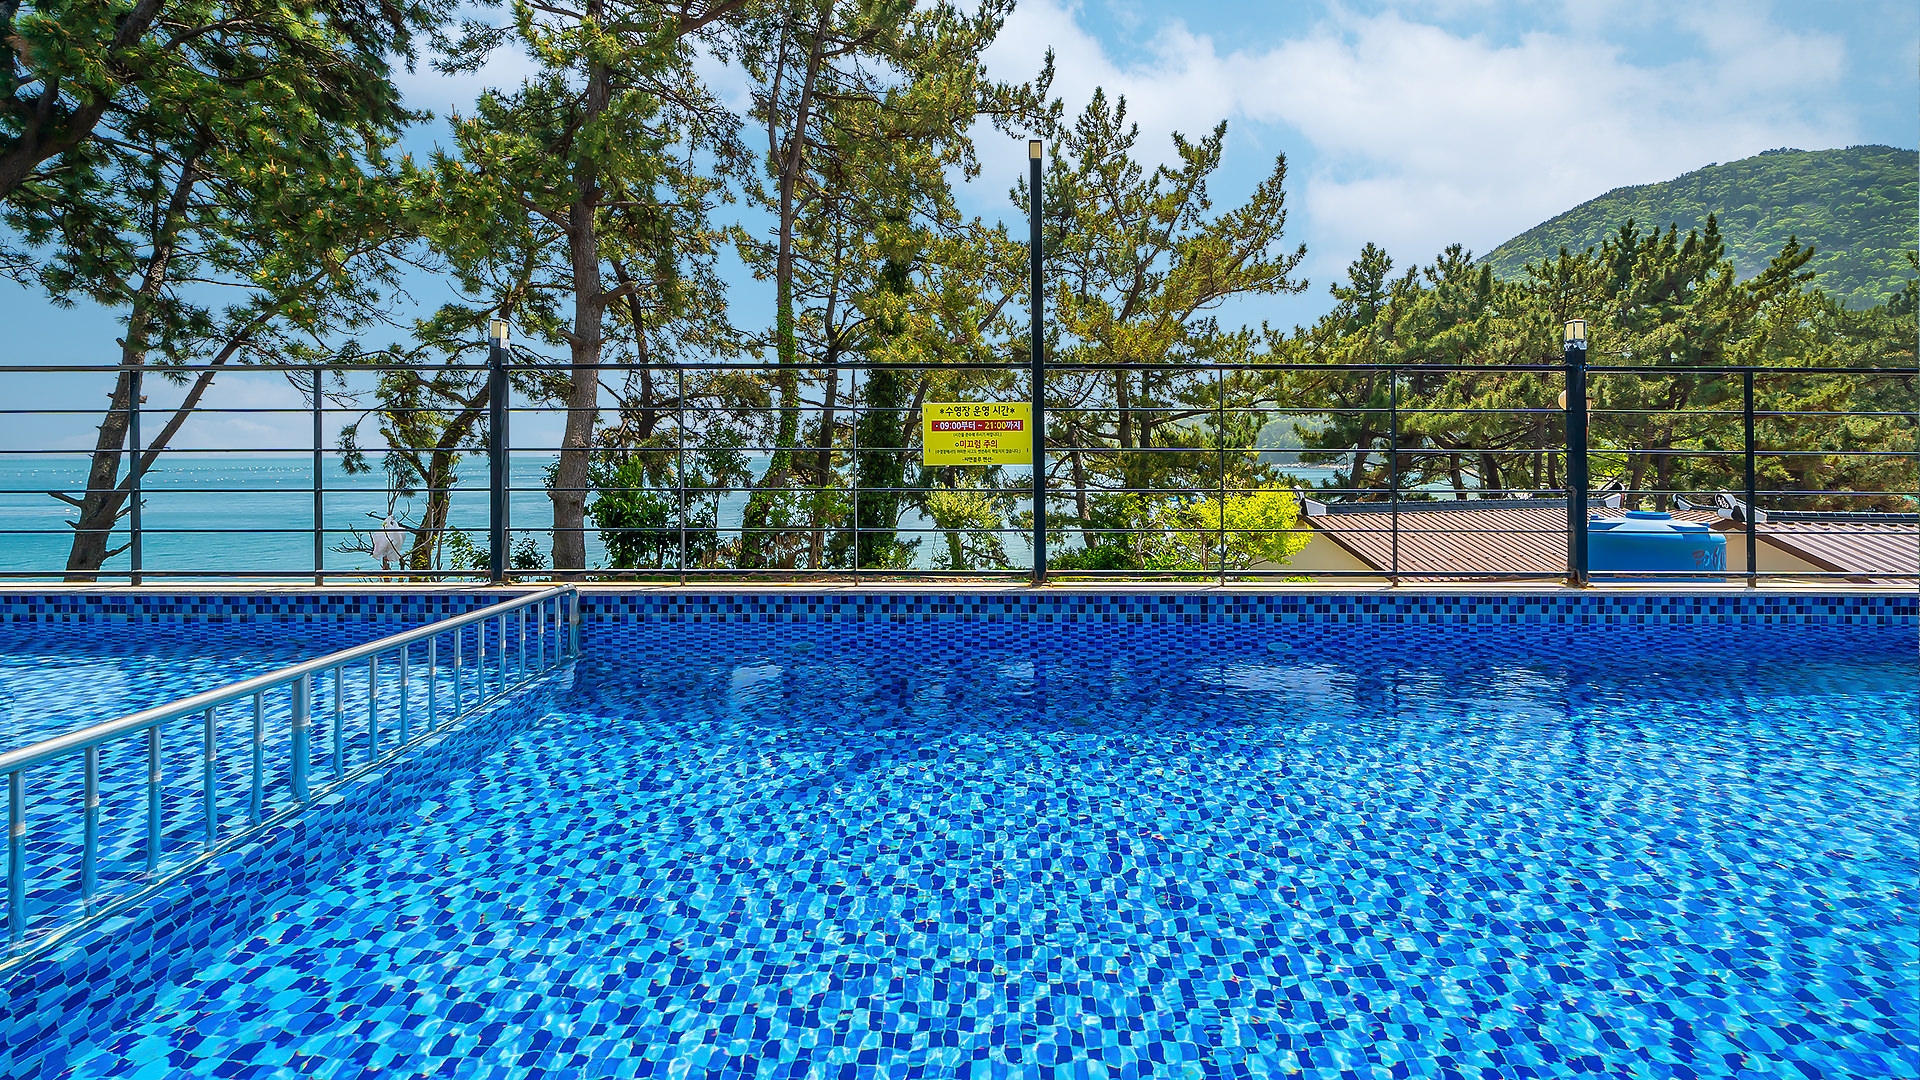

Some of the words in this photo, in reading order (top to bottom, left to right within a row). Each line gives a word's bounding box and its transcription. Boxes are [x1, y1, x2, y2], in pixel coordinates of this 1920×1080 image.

[945, 405, 971, 417] 수영장
[973, 405, 990, 417] 운영
[992, 405, 1010, 416] 시간
[939, 421, 976, 430] 09:00부터
[984, 420, 1021, 430] 21:00까지
[960, 439, 981, 449] 미끄럼
[983, 439, 998, 448] 주의
